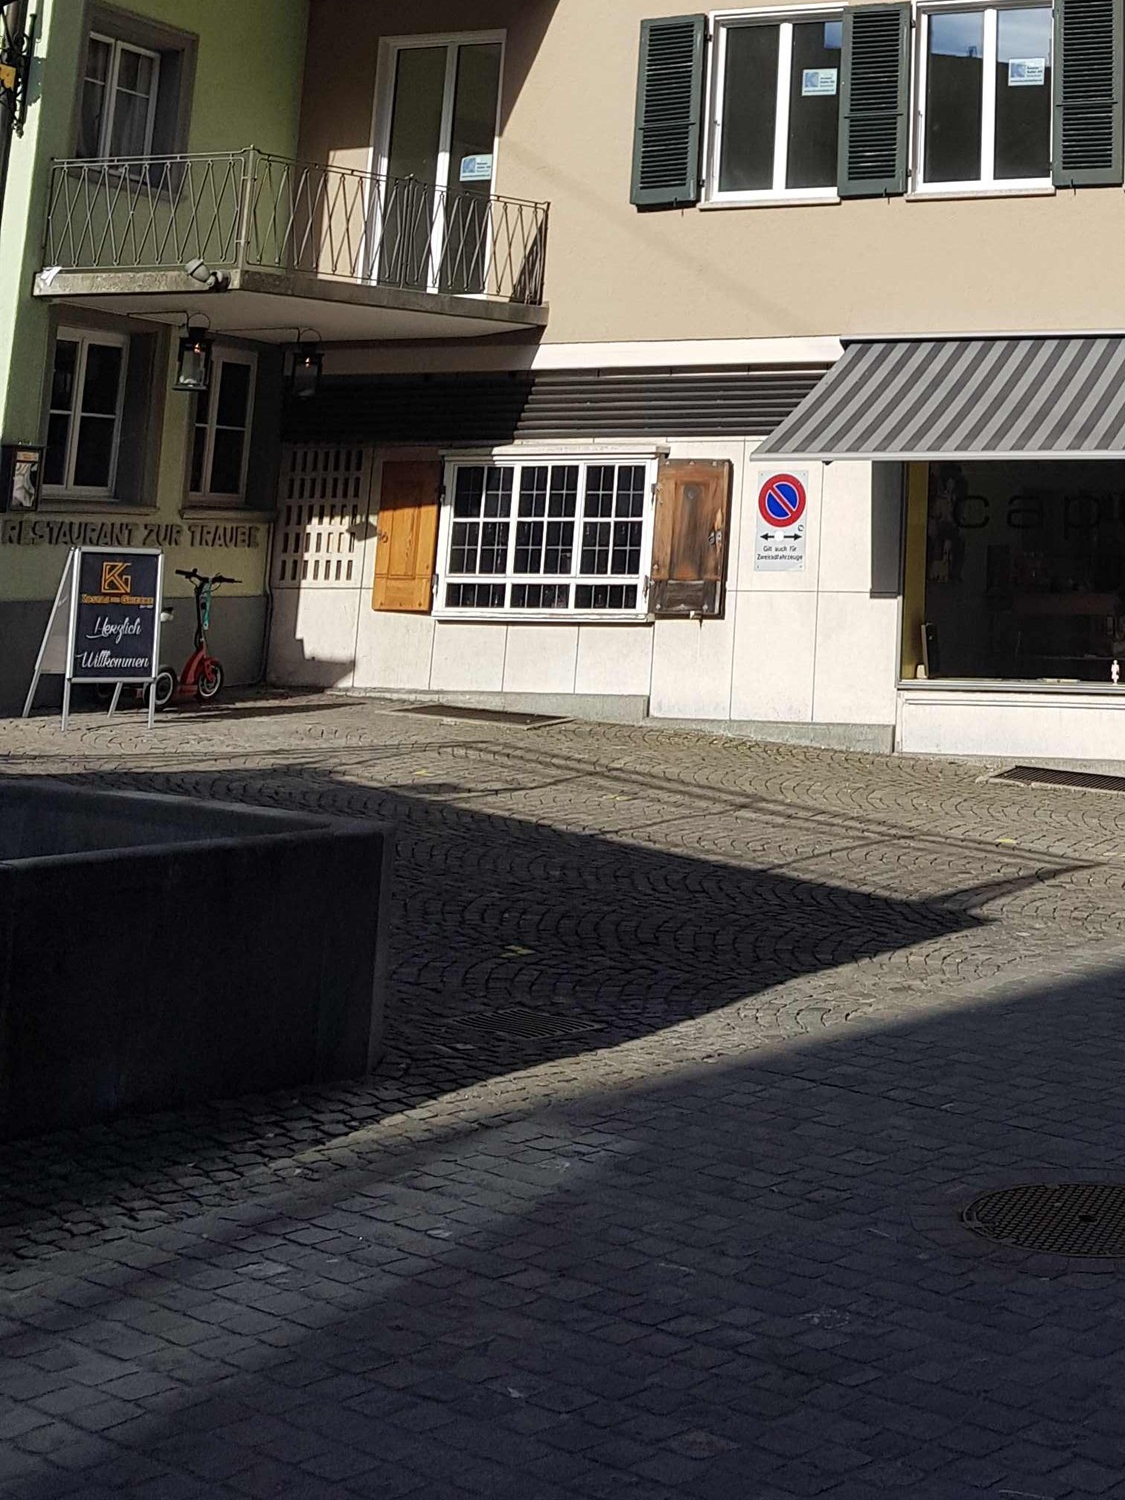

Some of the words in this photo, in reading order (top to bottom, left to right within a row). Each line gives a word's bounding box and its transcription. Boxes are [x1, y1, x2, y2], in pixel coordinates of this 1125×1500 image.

[3, 520, 136, 546] RESTAURANT
[142, 522, 184, 547] ZUR
[188, 523, 261, 548] TRAUBE
[86, 617, 141, 643] Herzlich
[75, 649, 150, 668] Willkommen
